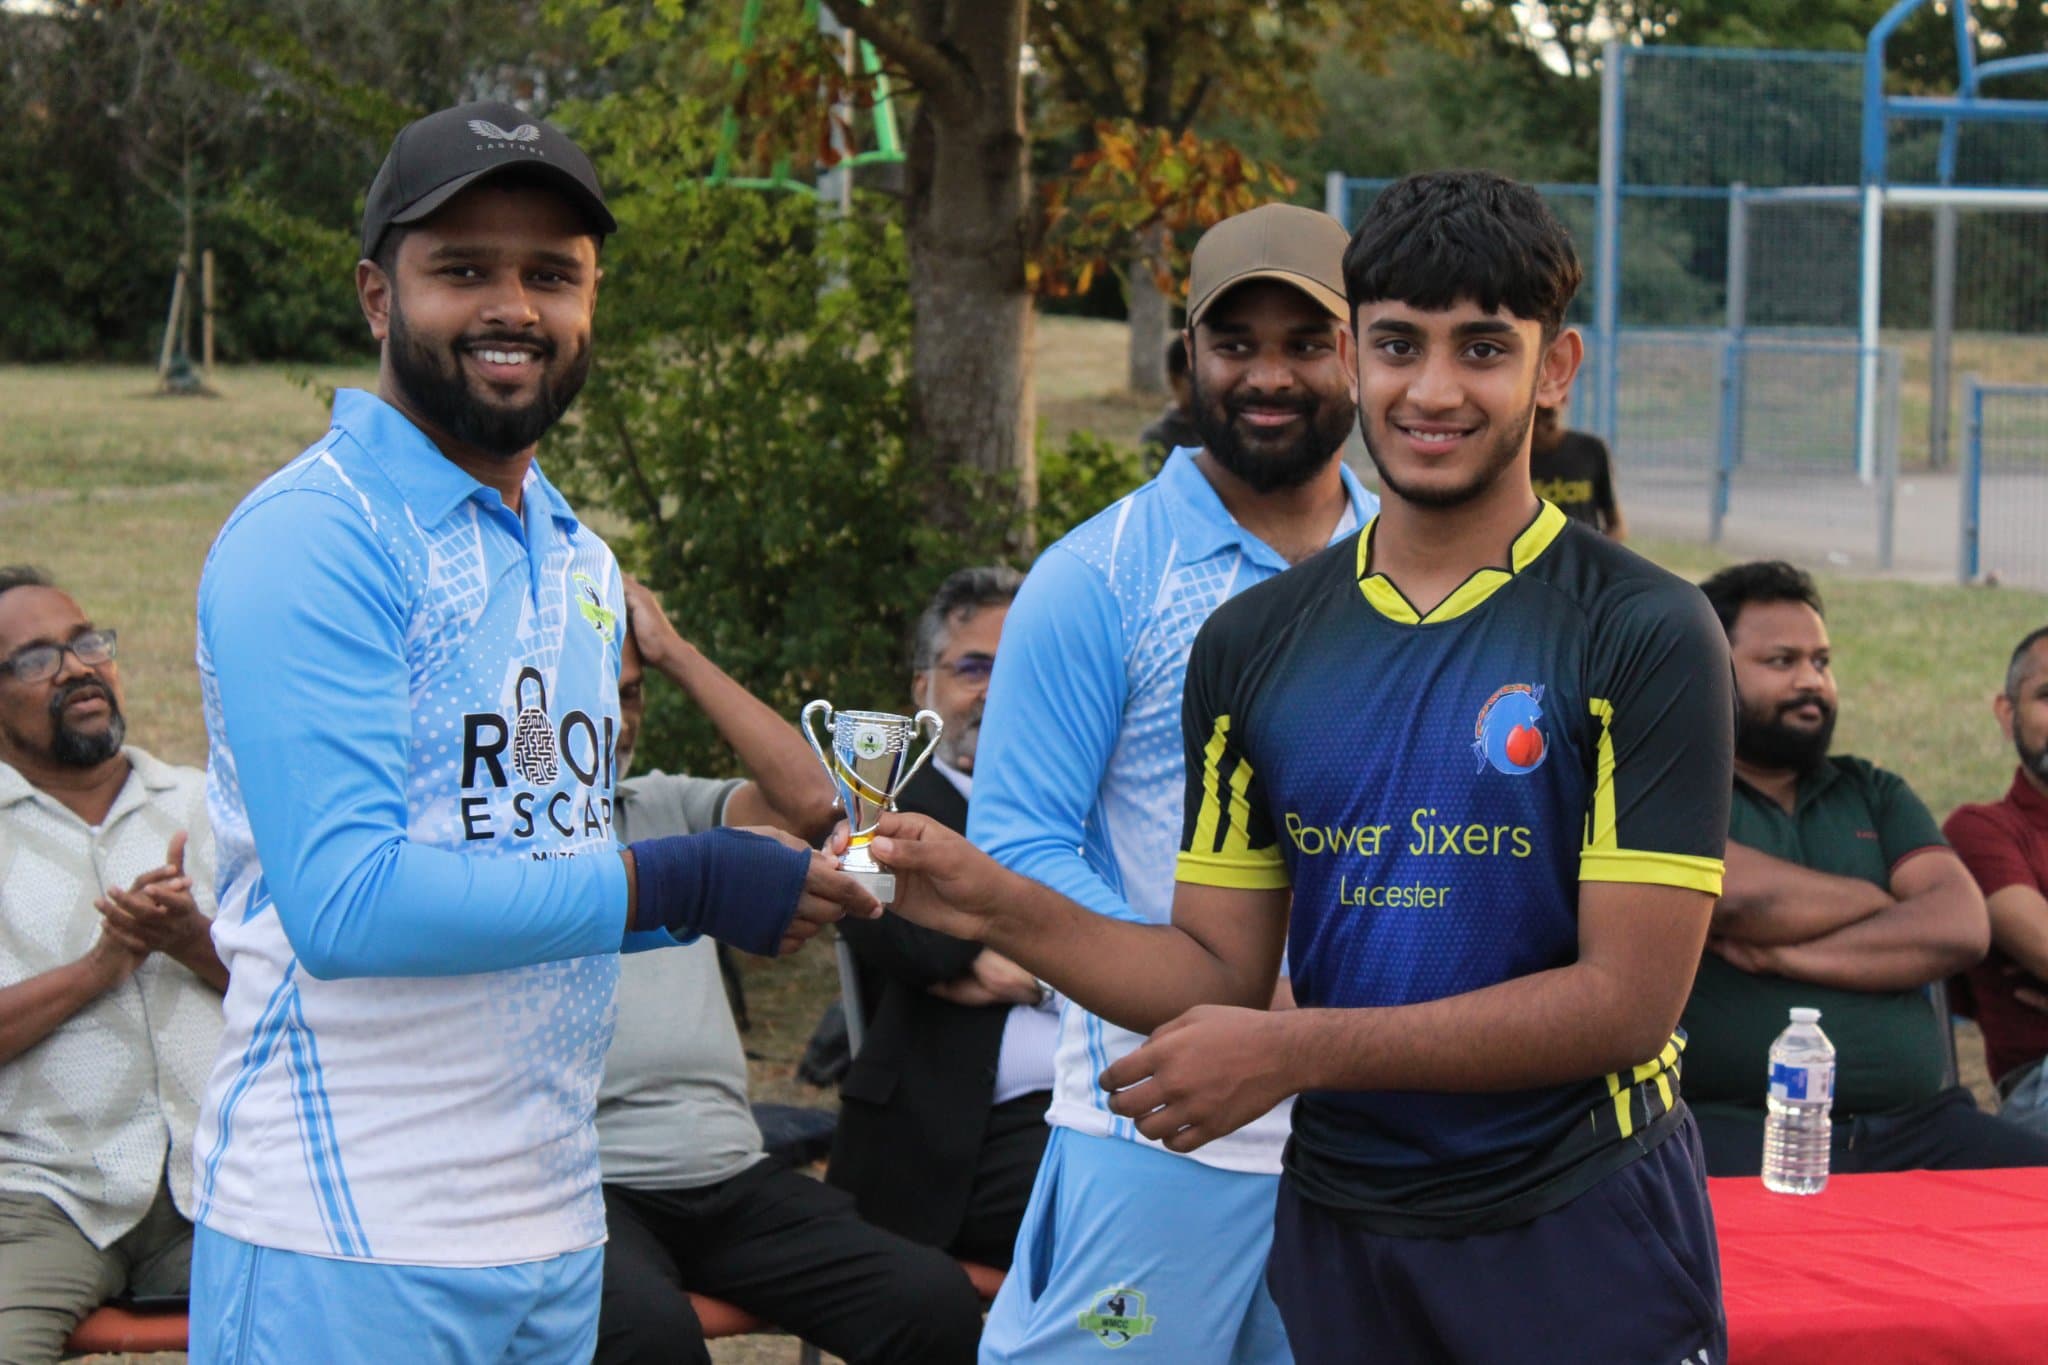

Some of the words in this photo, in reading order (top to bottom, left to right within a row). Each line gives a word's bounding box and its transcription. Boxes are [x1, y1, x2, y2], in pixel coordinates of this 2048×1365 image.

[461, 667, 614, 789] ROO
[1285, 812, 1391, 856] Power
[1409, 808, 1533, 858] Sixers
